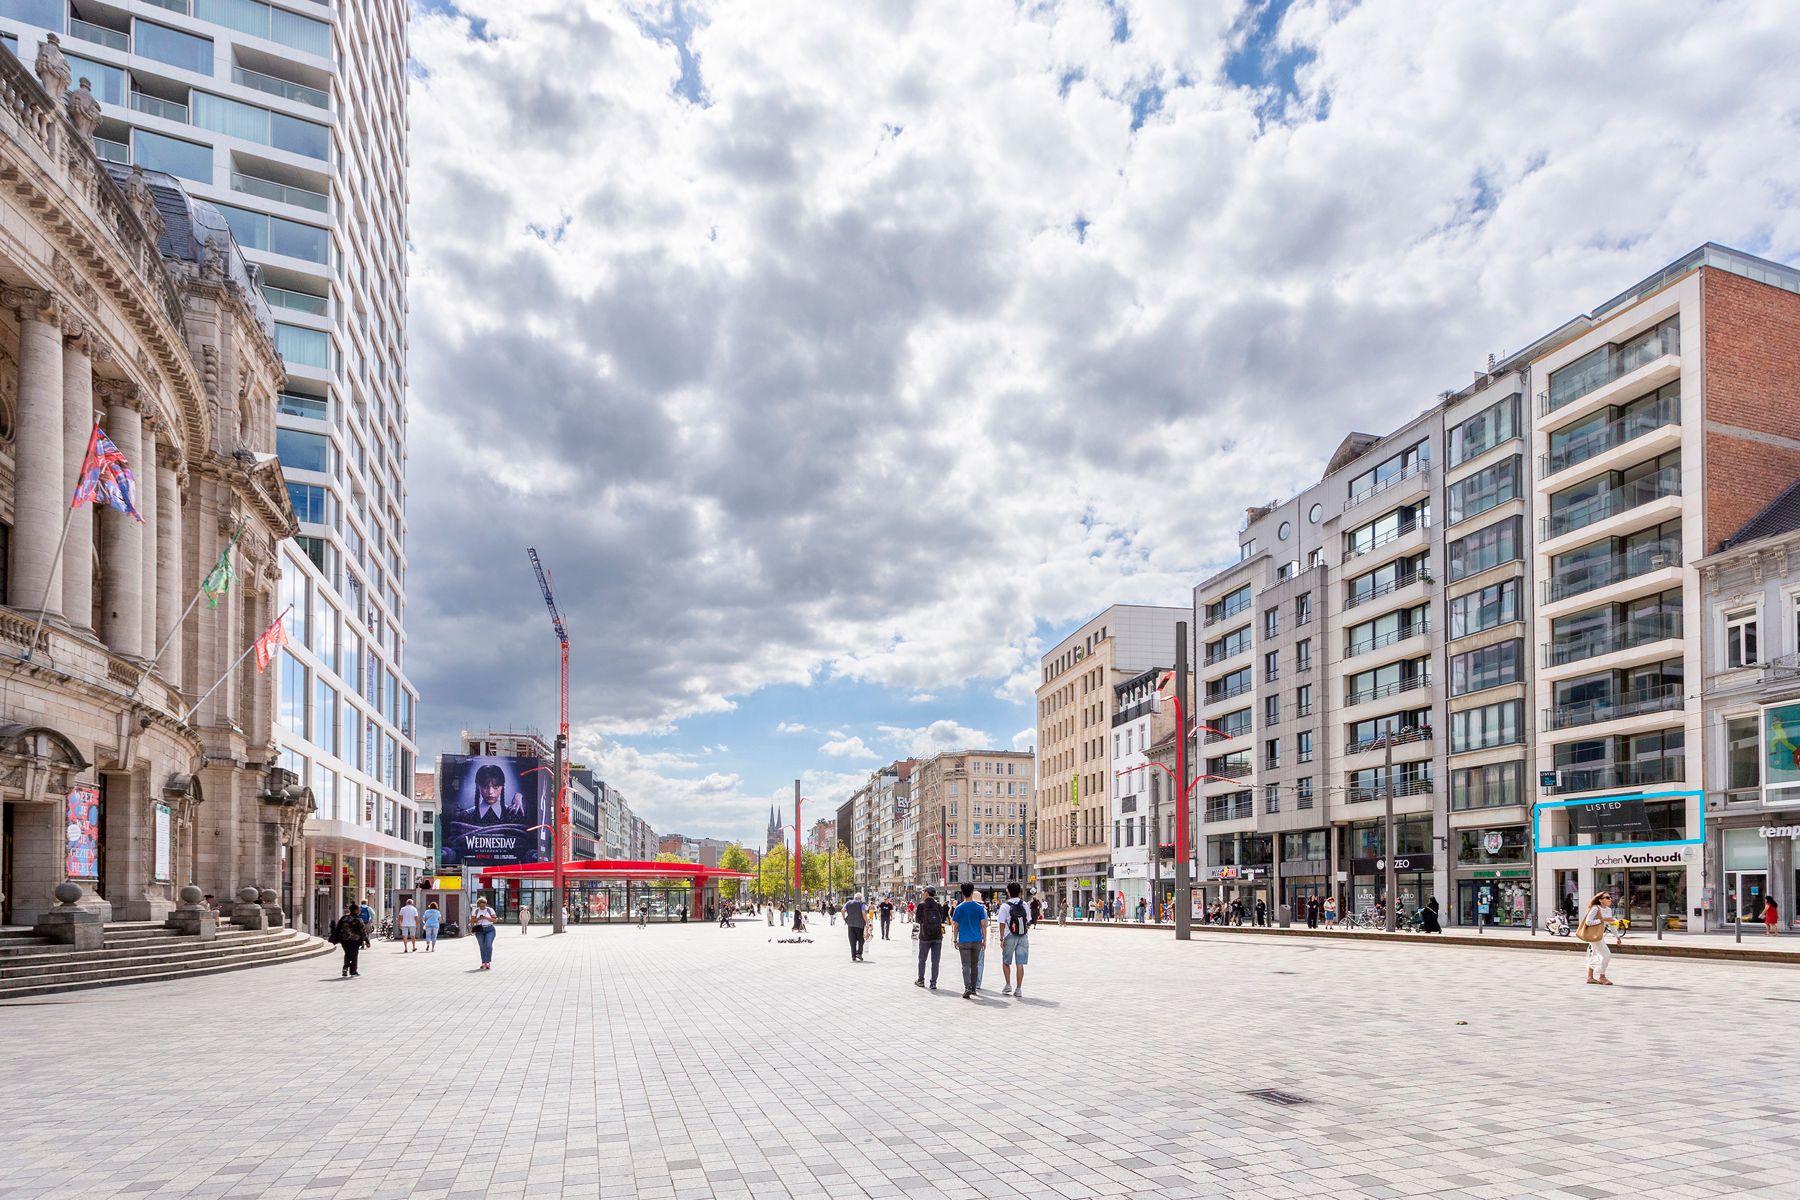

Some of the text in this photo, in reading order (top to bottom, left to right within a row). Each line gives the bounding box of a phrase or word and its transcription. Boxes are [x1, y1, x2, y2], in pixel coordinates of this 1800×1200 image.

[1585, 802, 1621, 811] LISTED
[465, 836, 516, 849] WEDNESDAY
[1594, 855, 1623, 866] Jochen
